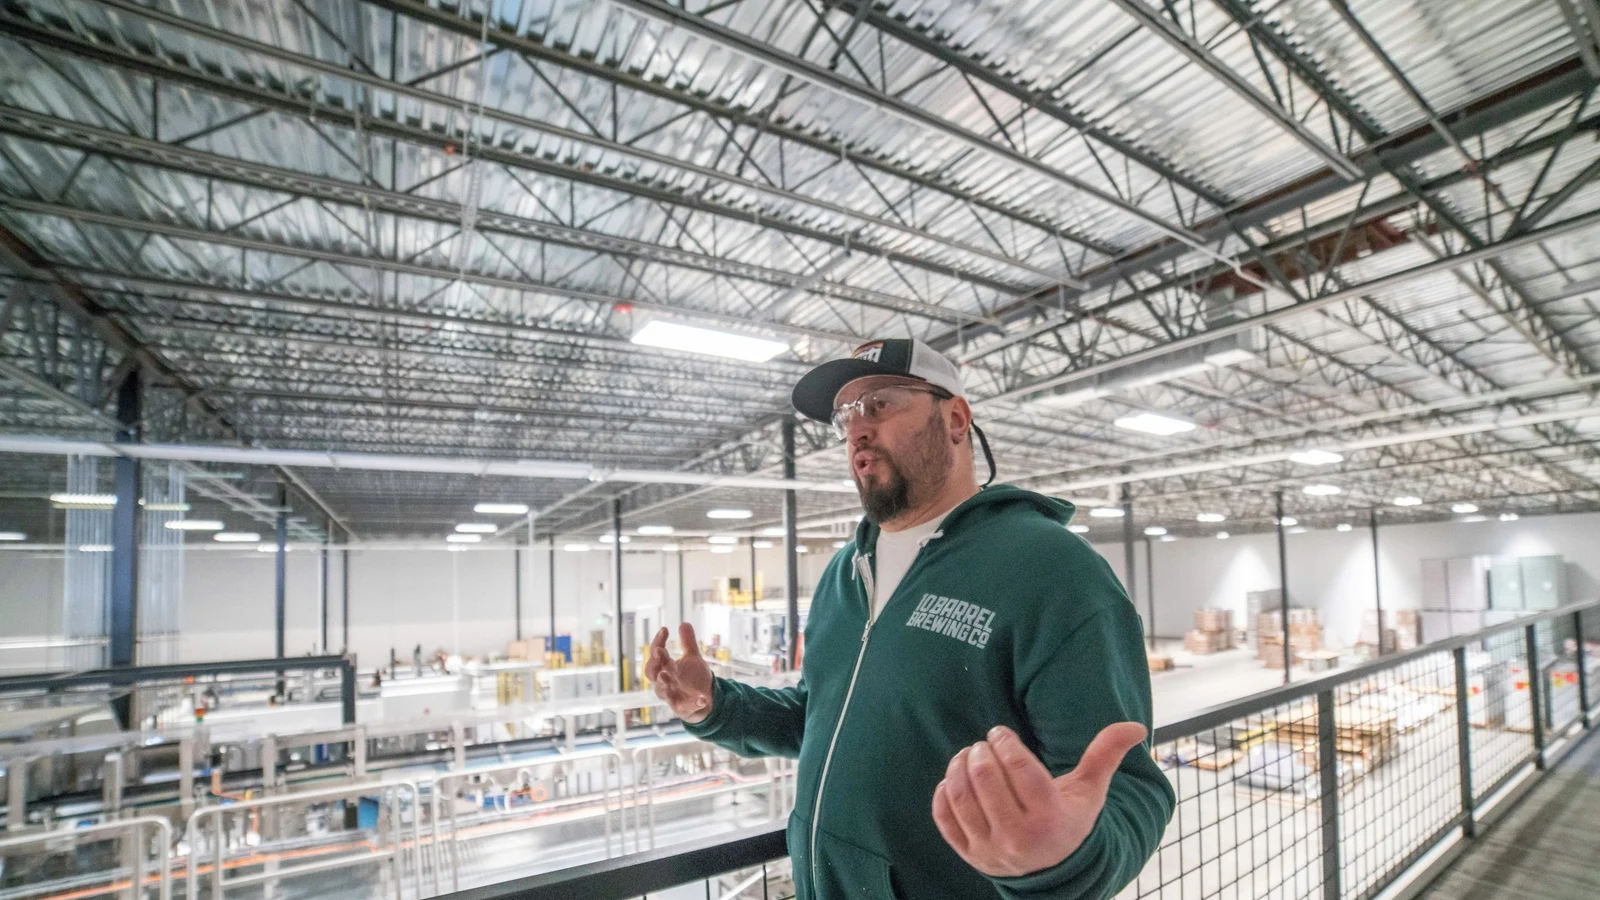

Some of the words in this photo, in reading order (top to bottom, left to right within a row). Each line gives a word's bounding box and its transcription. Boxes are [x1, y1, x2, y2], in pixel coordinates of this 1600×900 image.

[906, 611, 970, 641] BREWING
[915, 593, 937, 612] 10
[929, 596, 996, 633] BARREL
